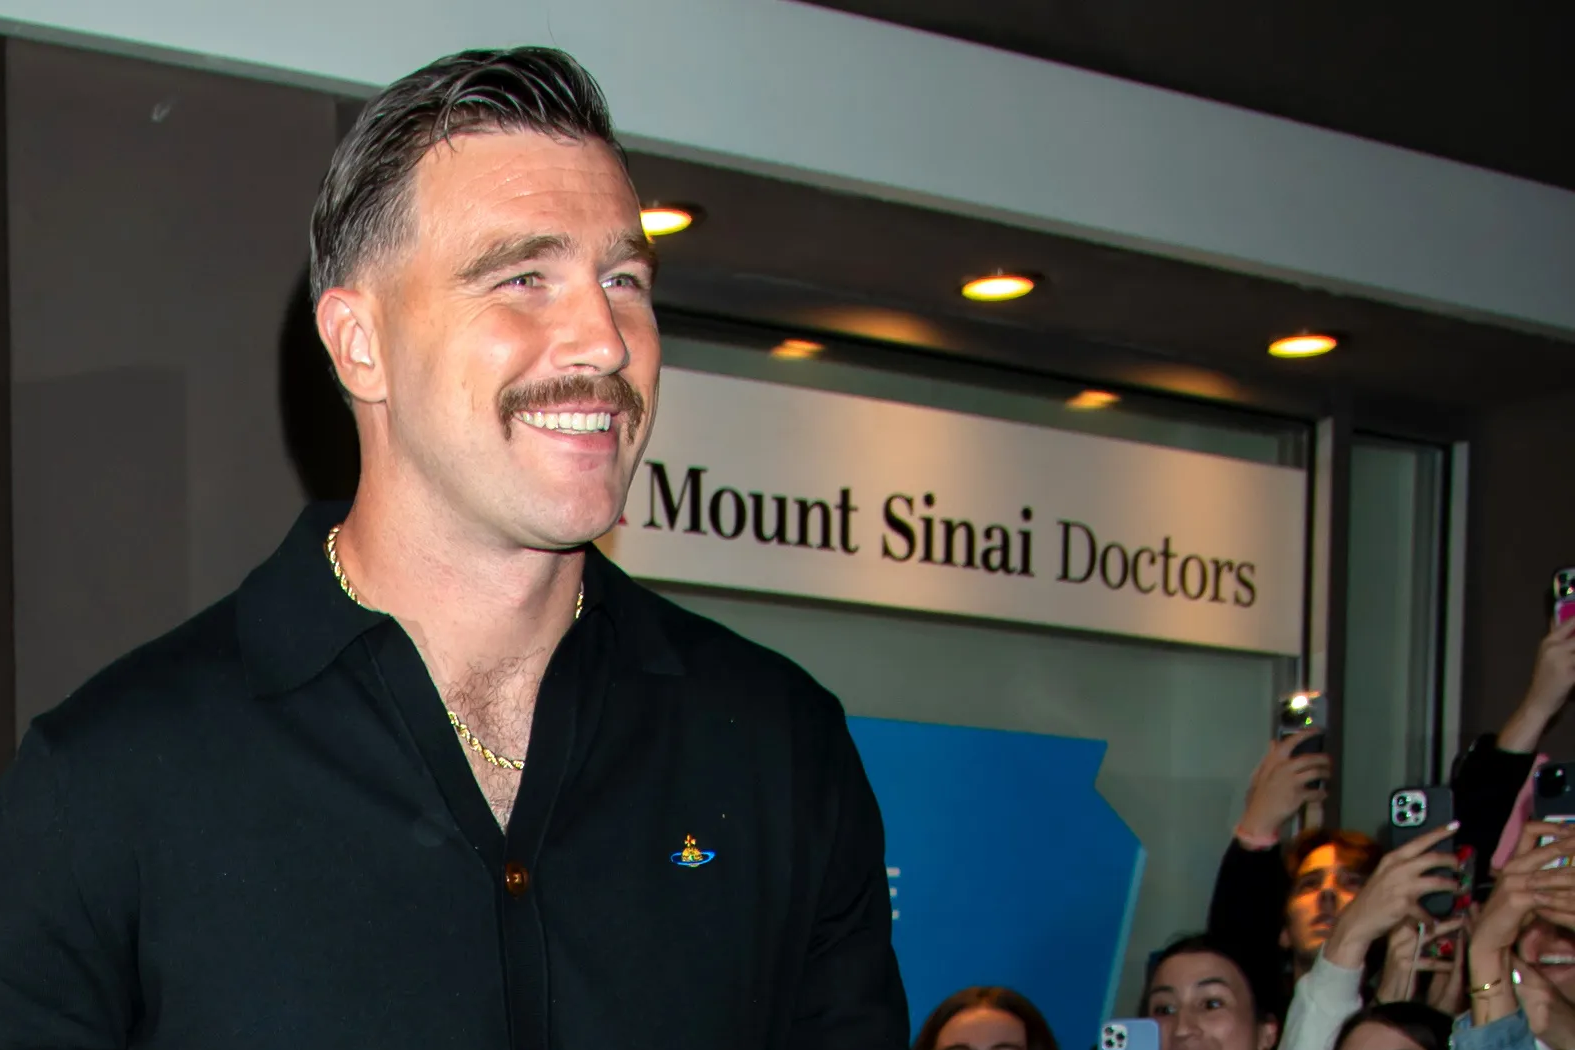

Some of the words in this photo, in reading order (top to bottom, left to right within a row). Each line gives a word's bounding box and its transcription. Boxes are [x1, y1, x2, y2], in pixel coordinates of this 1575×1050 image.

[643, 459, 859, 556] Mount
[881, 488, 1035, 578] Sinai
[1057, 519, 1257, 609] Doctors
